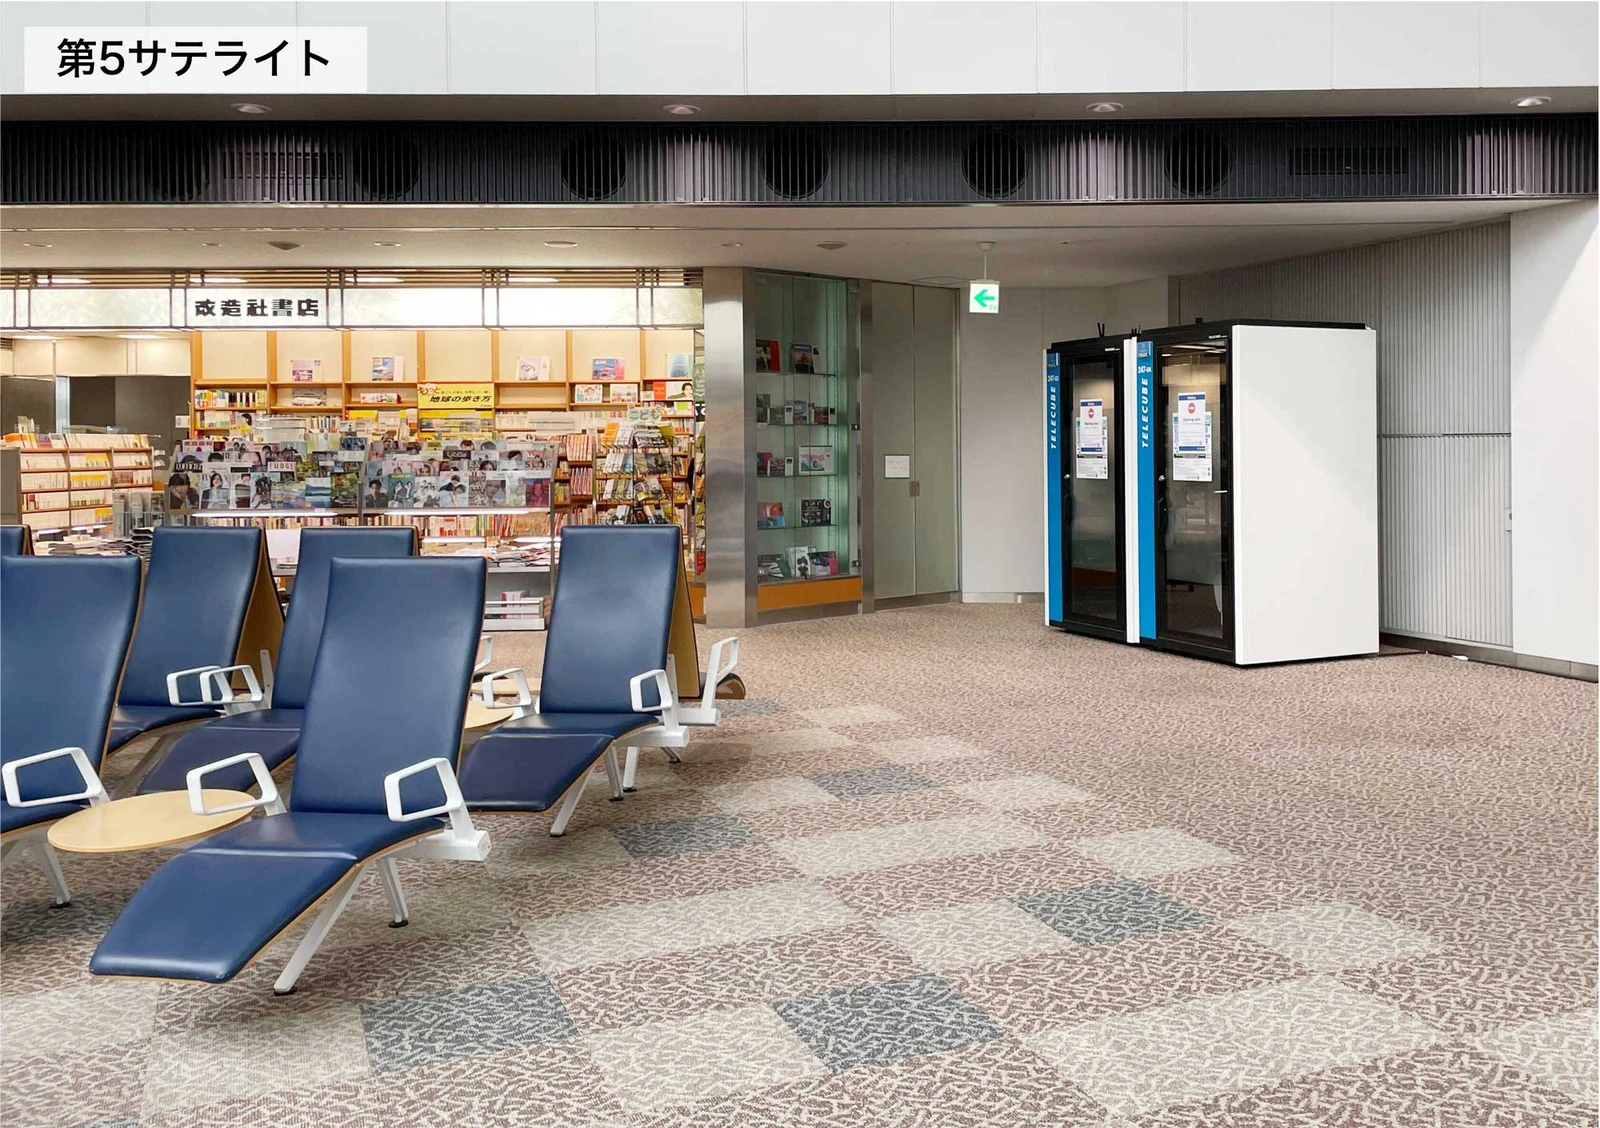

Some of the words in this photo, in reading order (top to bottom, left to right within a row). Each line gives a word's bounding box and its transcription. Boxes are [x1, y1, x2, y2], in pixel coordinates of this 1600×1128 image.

[194, 298, 319, 317] 改造社書店
[429, 395, 492, 403] 地球の歩き方
[629, 408, 662, 420] こども
[1141, 378, 1149, 448] TELECUBE
